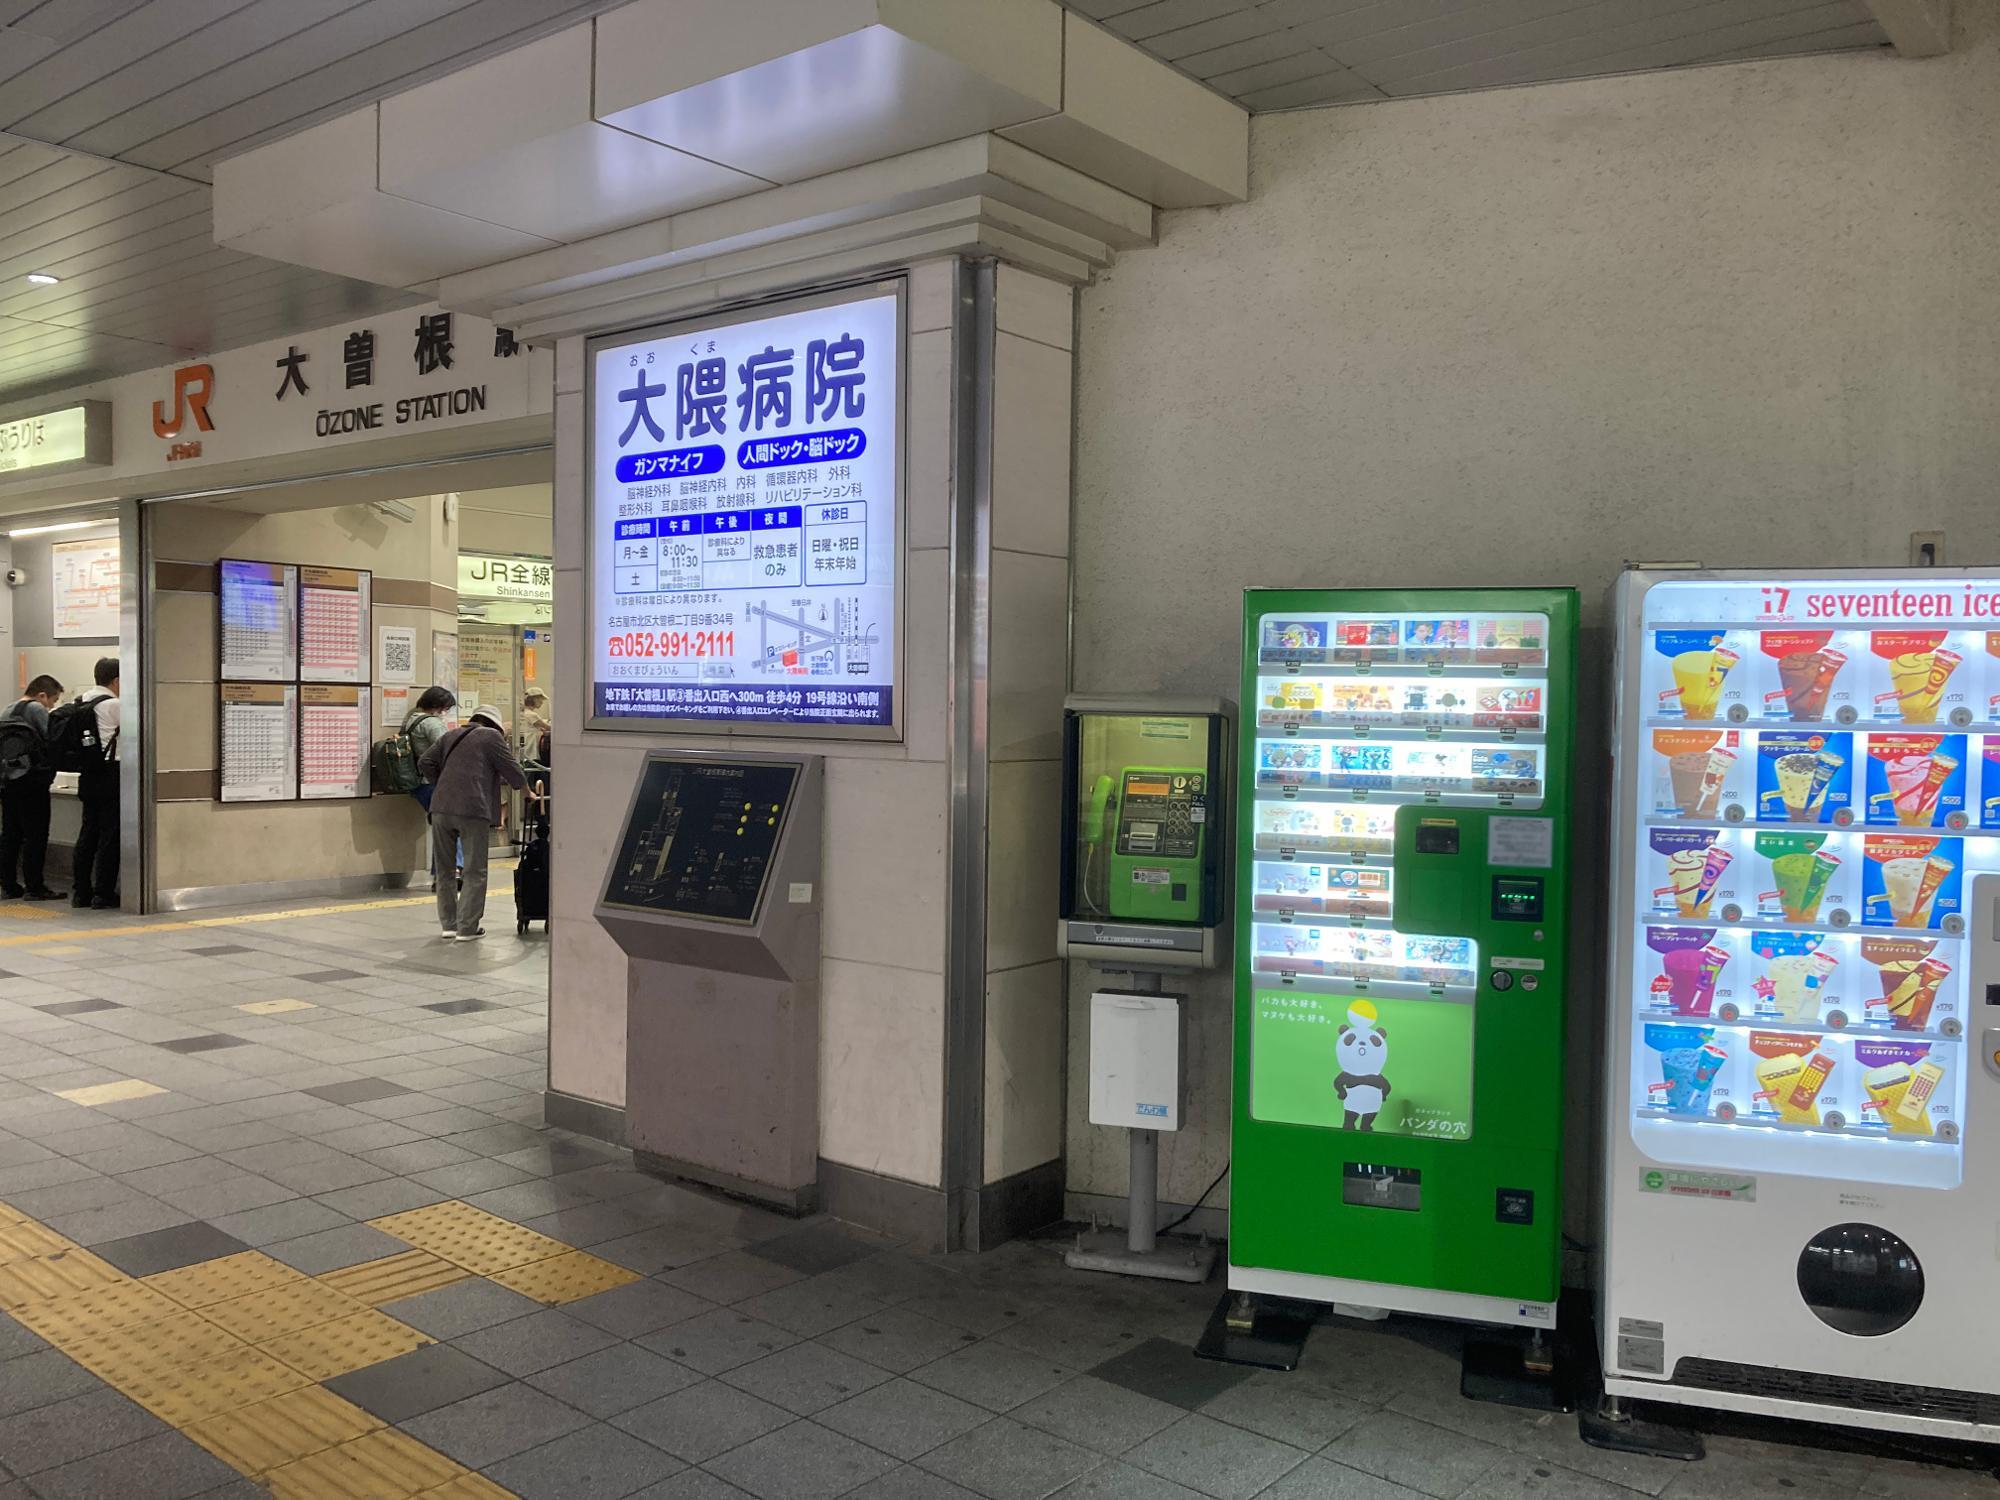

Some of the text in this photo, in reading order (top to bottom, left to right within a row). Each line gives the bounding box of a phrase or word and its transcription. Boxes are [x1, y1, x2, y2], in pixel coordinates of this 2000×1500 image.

[618, 332, 866, 448] 大隈病院
[152, 363, 215, 438] JR
[395, 384, 488, 425] STATION
[742, 433, 860, 465] 人間ドック・脳ドック
[634, 452, 704, 477] ガンマナイフ
[627, 465, 850, 500] 脳神経外科 脳神経内科 内科 循環器内科 外科
[619, 482, 862, 517] 整形外科 耳鼻咽喉科 放射線科 リハビリテーション科
[715, 515, 738, 529] 午後
[764, 511, 788, 526] 夜間
[821, 507, 849, 521] 休診日
[669, 519, 691, 533] 午前
[753, 543, 798, 561] 救急患者
[671, 556, 698, 569] 11:30
[765, 563, 787, 577] のみ
[814, 557, 857, 572] 年末年始
[471, 560, 551, 587] JR全線
[496, 585, 551, 598] Shinkansen
[1807, 583, 2000, 617] seventeen ice
[766, 689, 802, 705] 徒歩4分
[1399, 1117, 1467, 1135] パンダの穴
